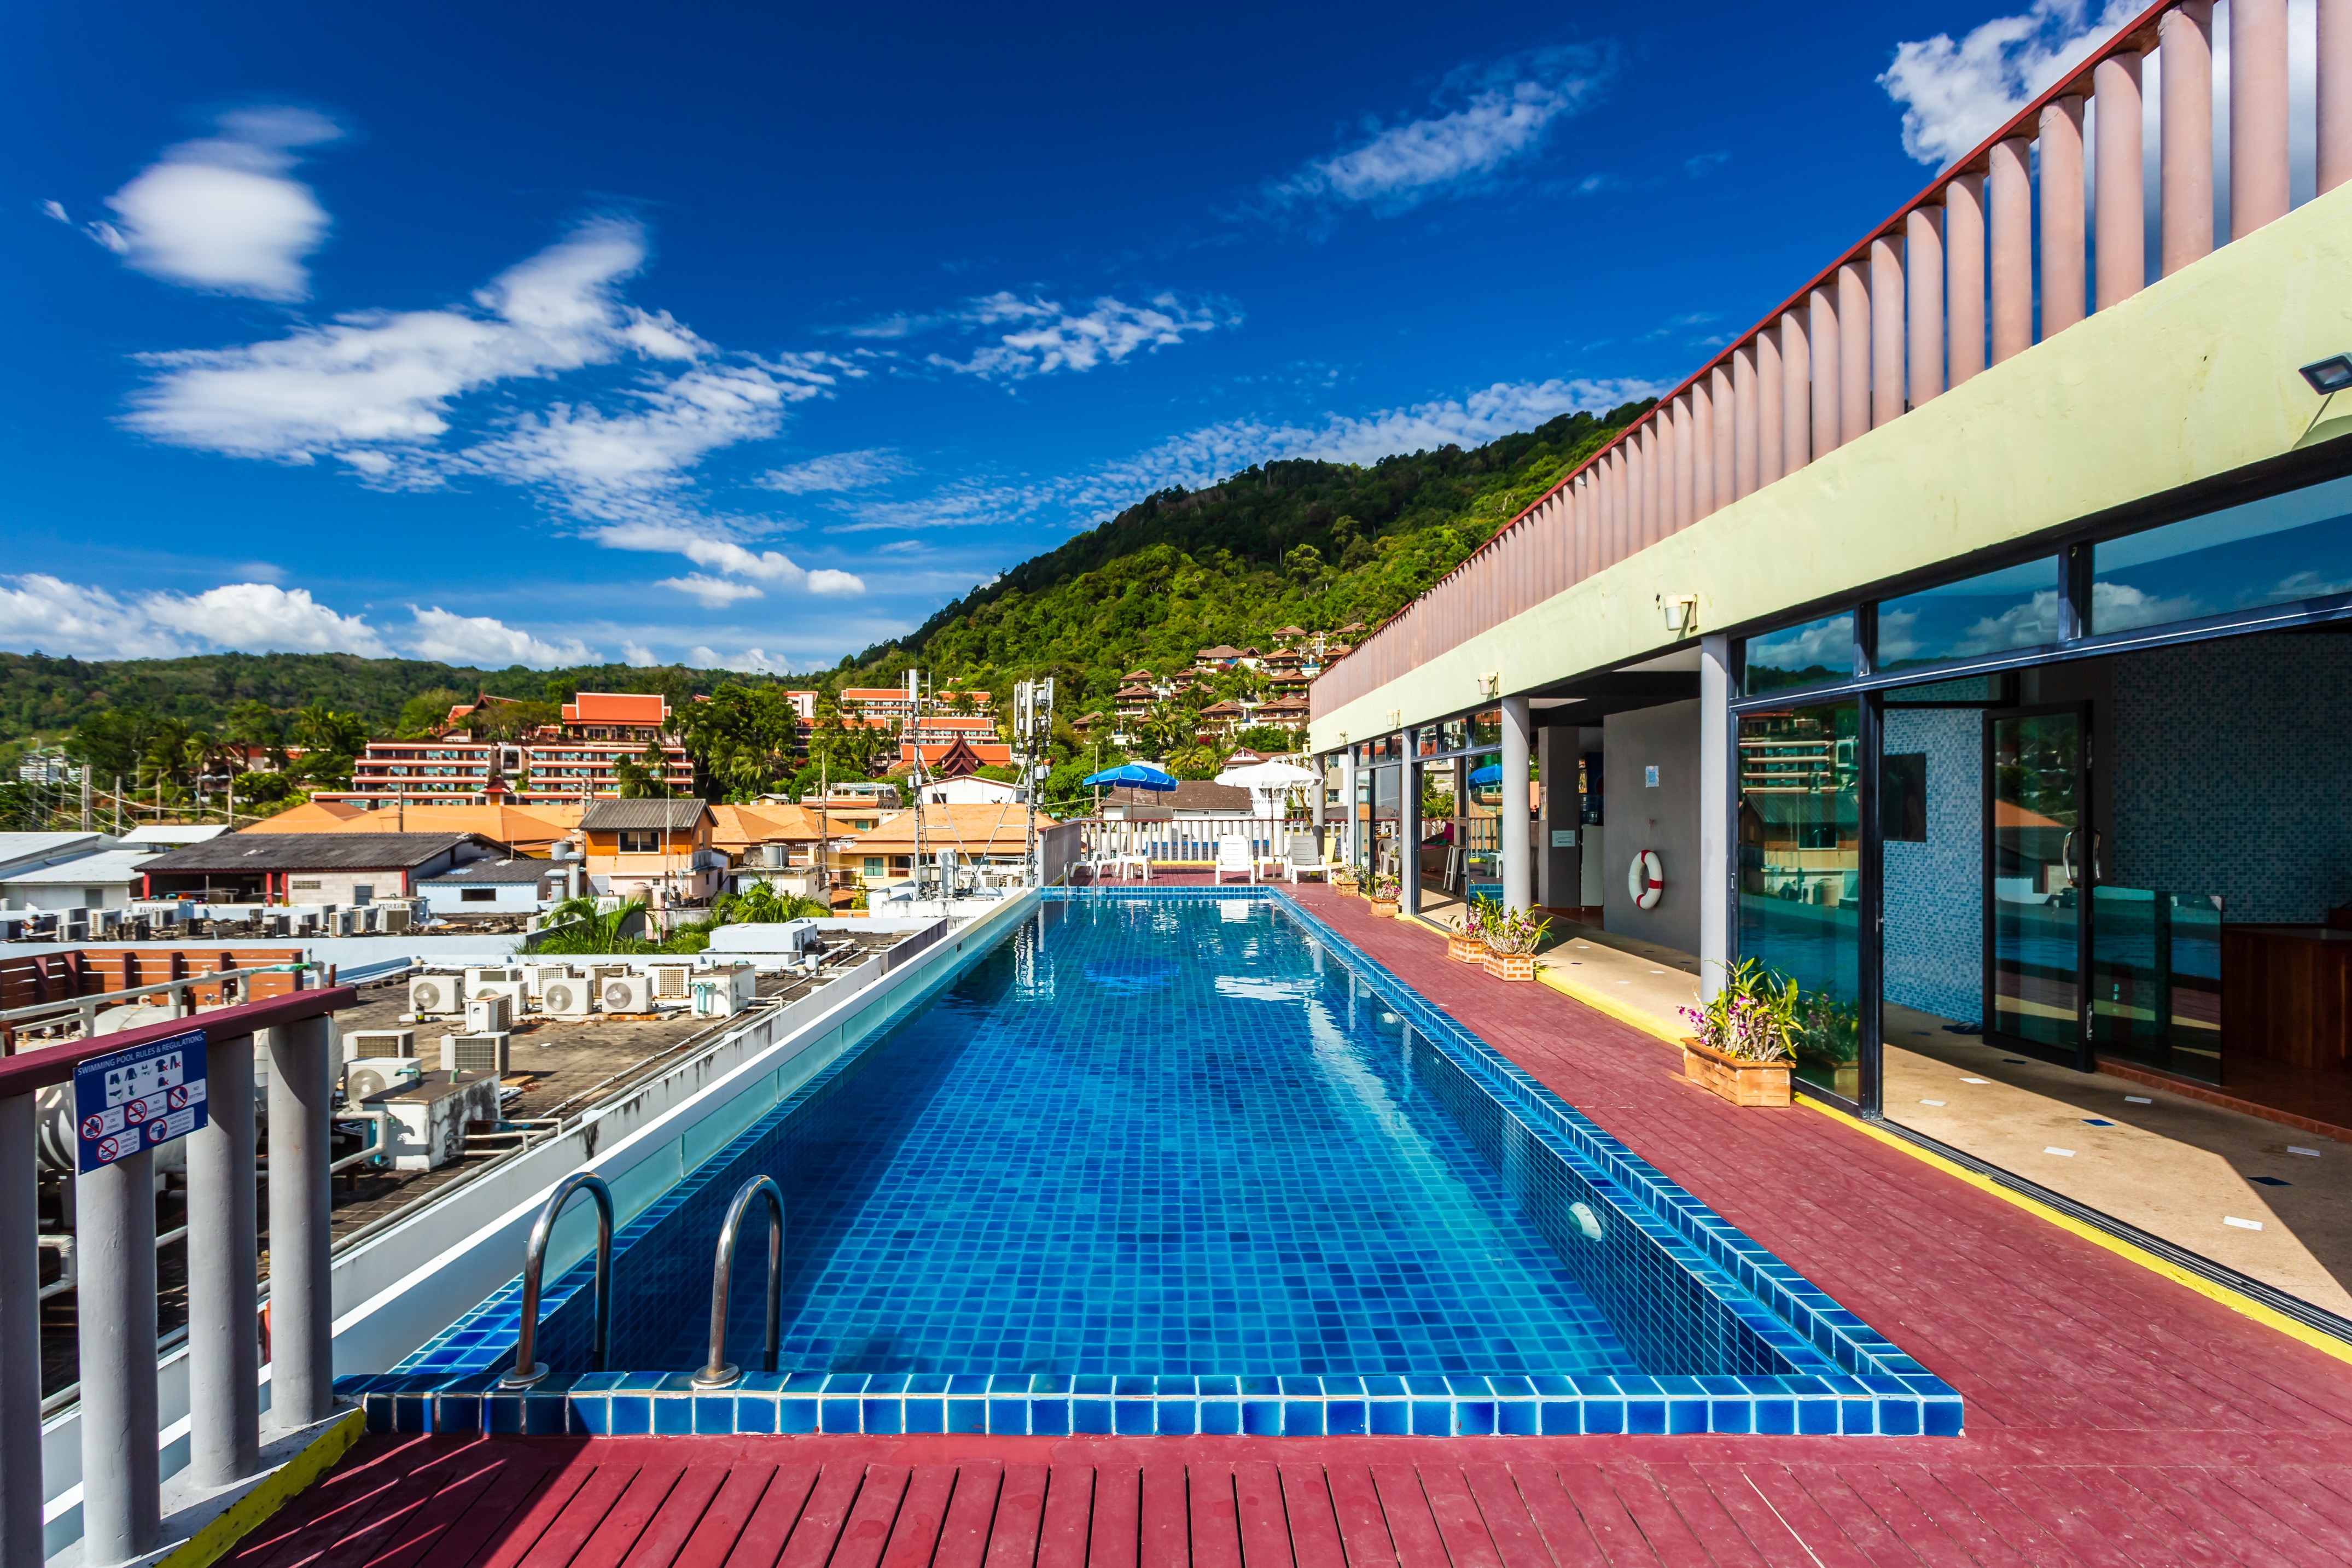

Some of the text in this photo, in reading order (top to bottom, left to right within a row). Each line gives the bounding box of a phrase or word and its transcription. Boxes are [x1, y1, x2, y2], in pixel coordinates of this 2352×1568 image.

[78, 1059, 115, 1076] SWIMMING
[117, 1054, 135, 1064] POOL
[136, 1047, 155, 1059] RULES
[188, 1091, 205, 1100] SPITTING
[148, 1104, 166, 1114] SMOKING
